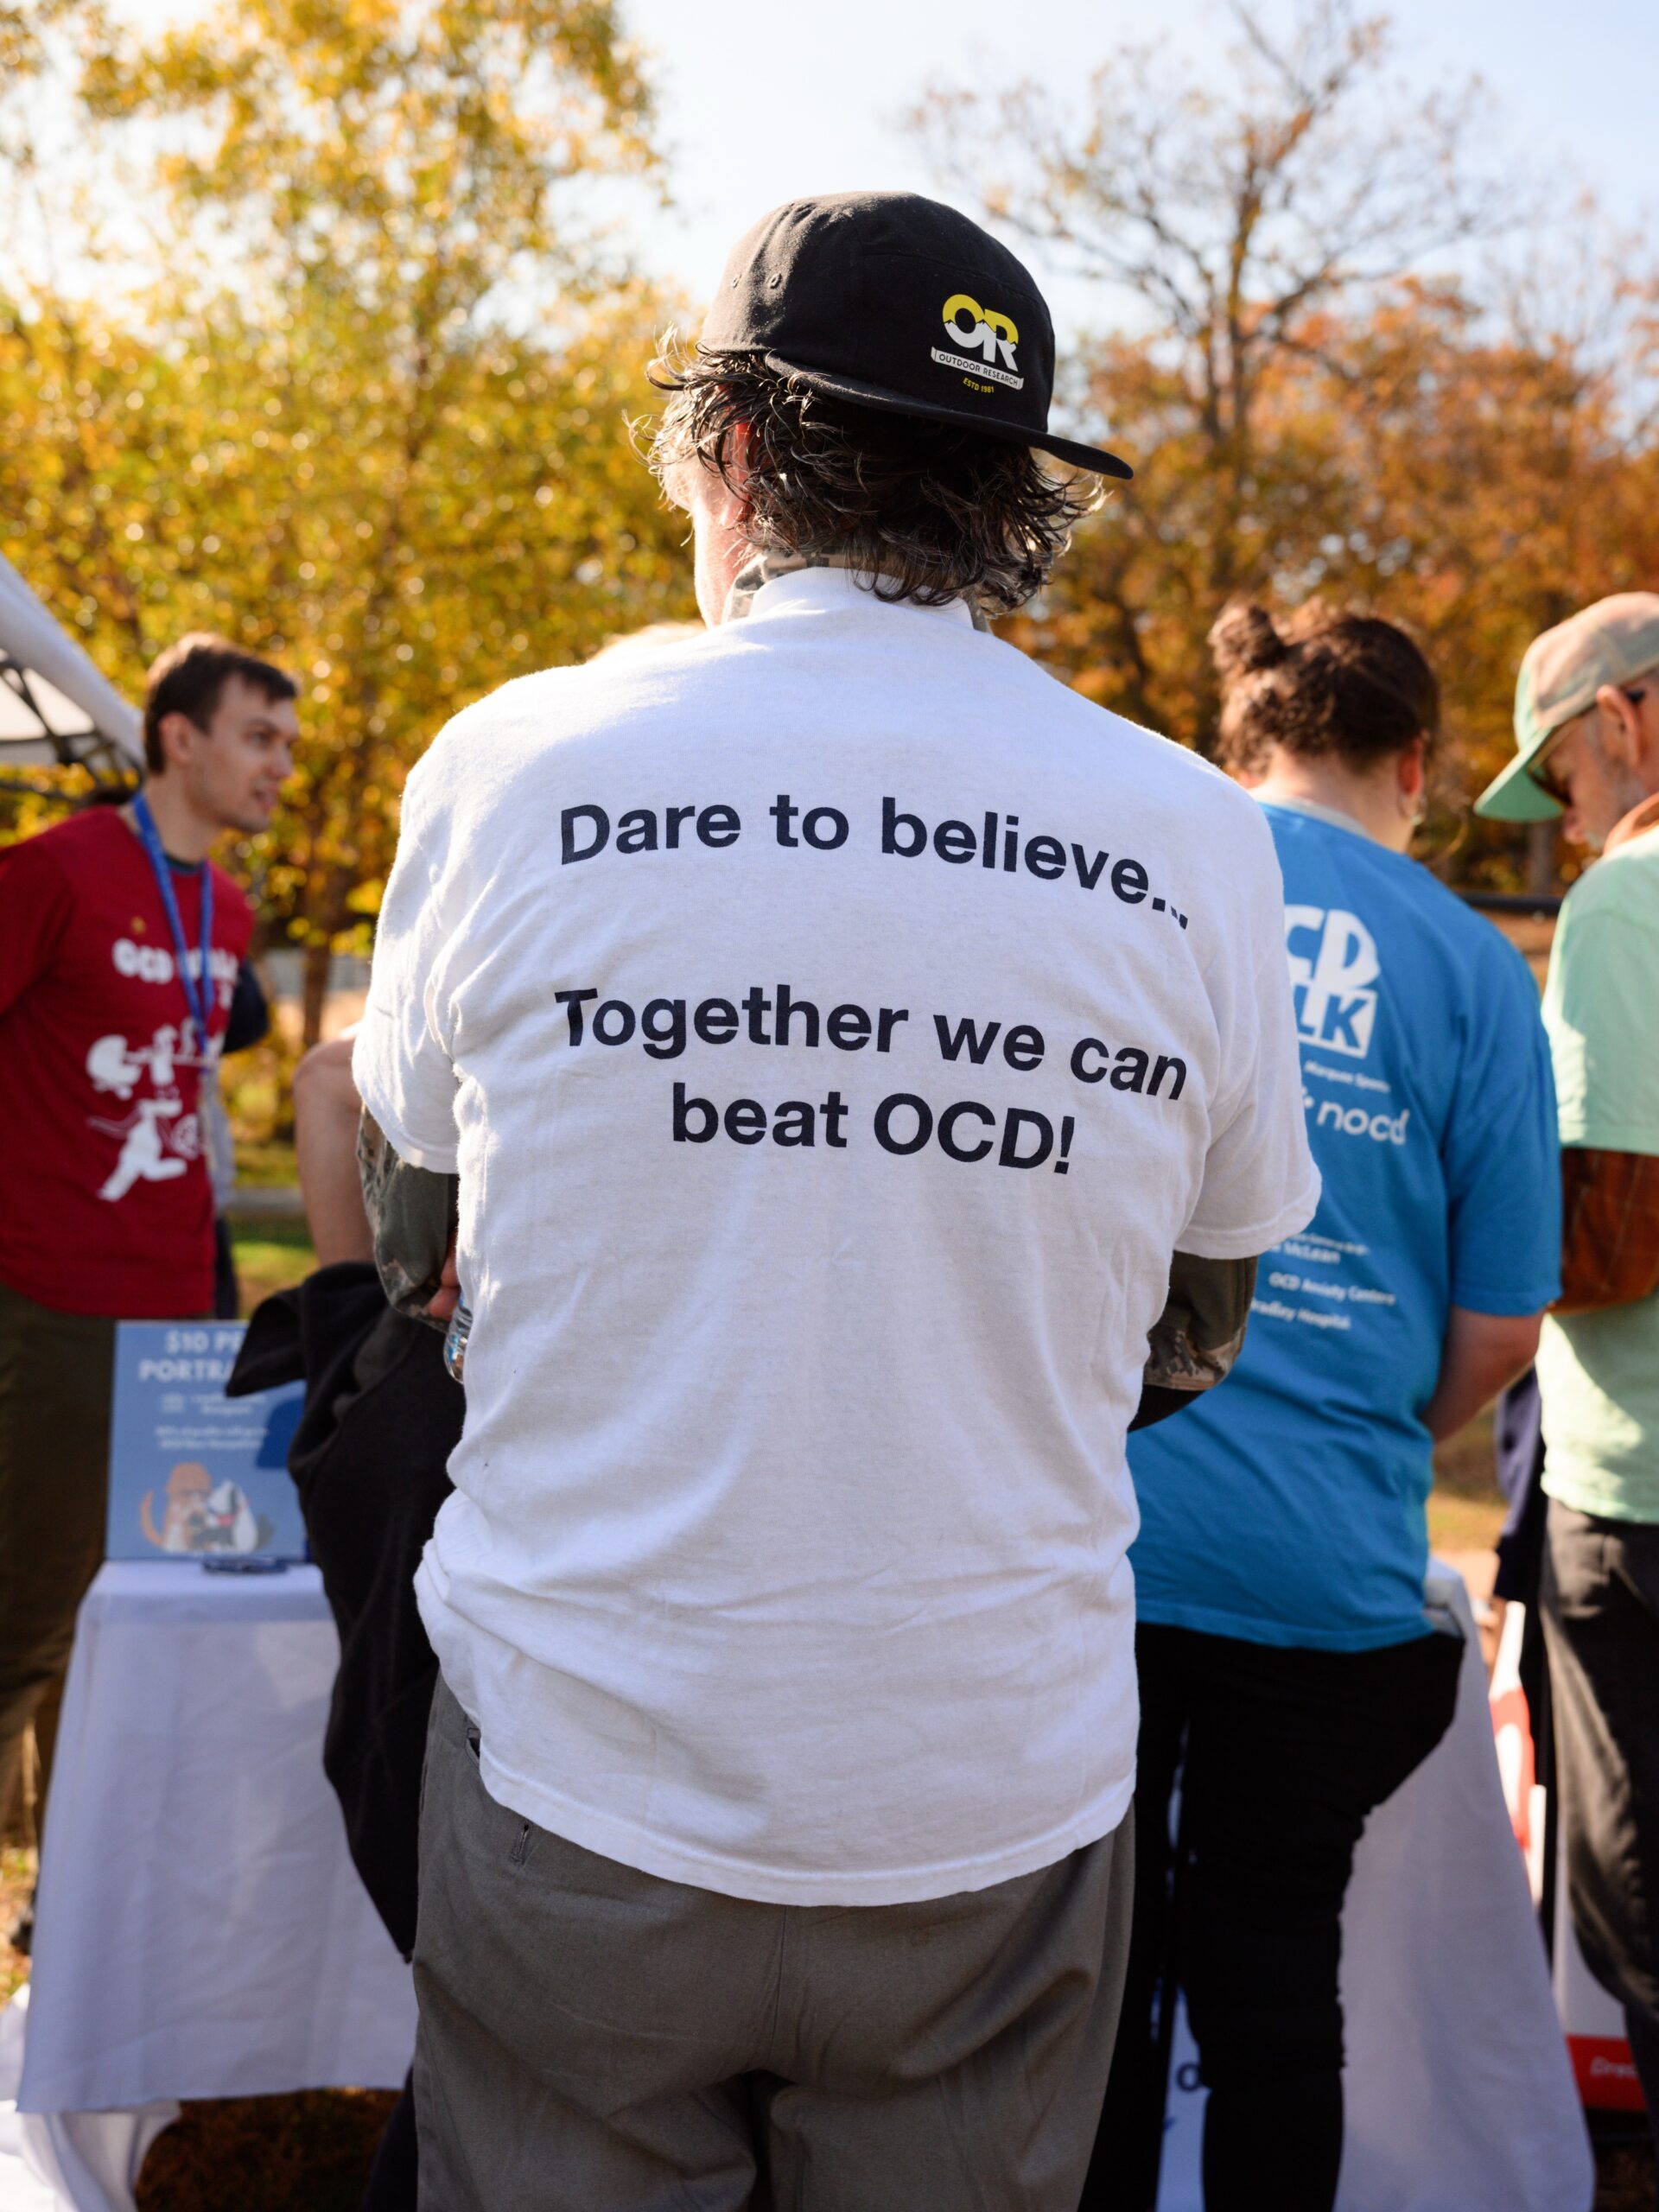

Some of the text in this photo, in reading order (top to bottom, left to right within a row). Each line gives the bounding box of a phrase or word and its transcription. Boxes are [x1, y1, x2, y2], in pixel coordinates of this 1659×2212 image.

[942, 294, 1019, 372] OR
[938, 353, 1019, 387] OUTDOOR RESEARCH
[963, 377, 980, 391] ESTD
[561, 794, 1188, 930] Dare to believe...
[1284, 905, 1381, 991] CD
[555, 984, 1187, 1101] Together we can
[1294, 983, 1368, 1049] LK
[672, 1082, 1076, 1175] beat OCD!
[1317, 1101, 1410, 1144] nocd
[1251, 1299, 1296, 1322] radley
[1268, 1272, 1300, 1291] OCD
